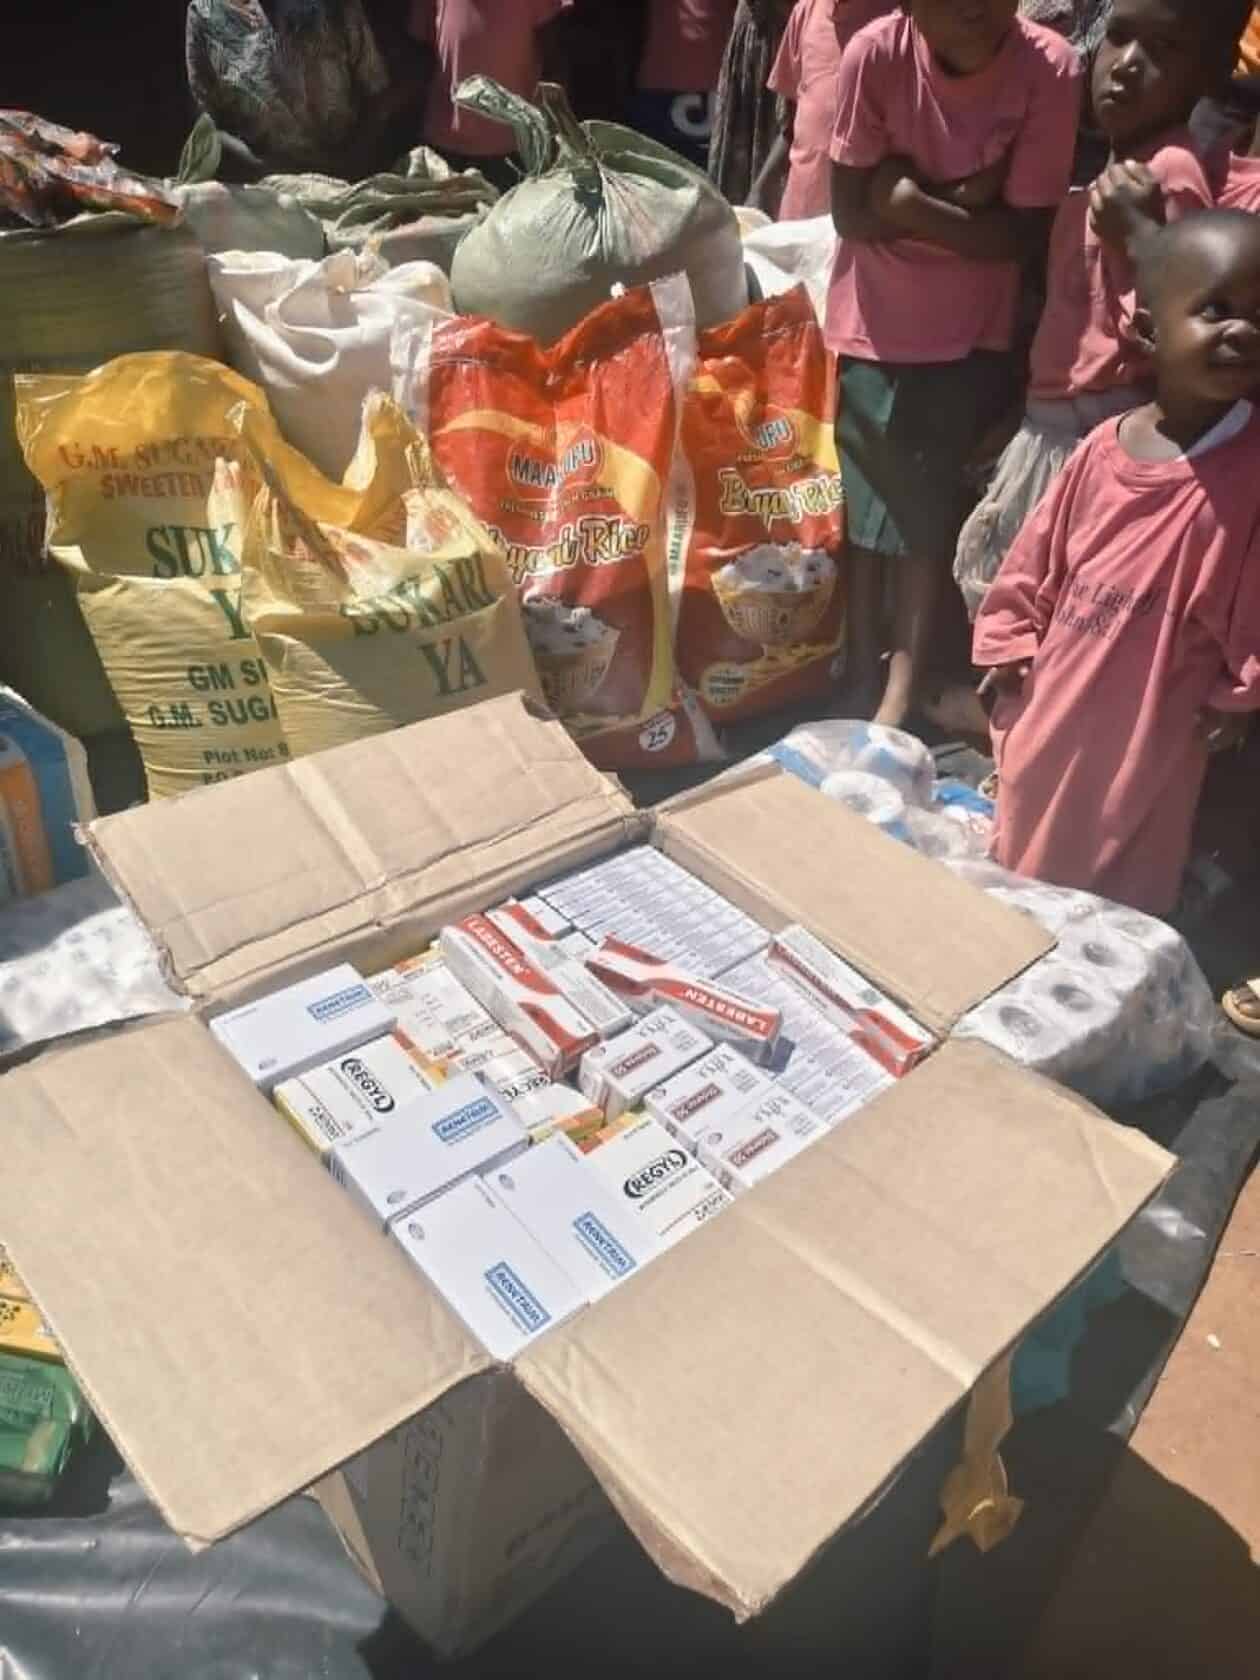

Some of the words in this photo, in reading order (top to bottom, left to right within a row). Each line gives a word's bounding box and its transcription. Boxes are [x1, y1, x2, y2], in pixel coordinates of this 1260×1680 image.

[188, 663, 235, 691] GM
[416, 633, 488, 696] YA
[629, 1153, 683, 1195] REGYL
